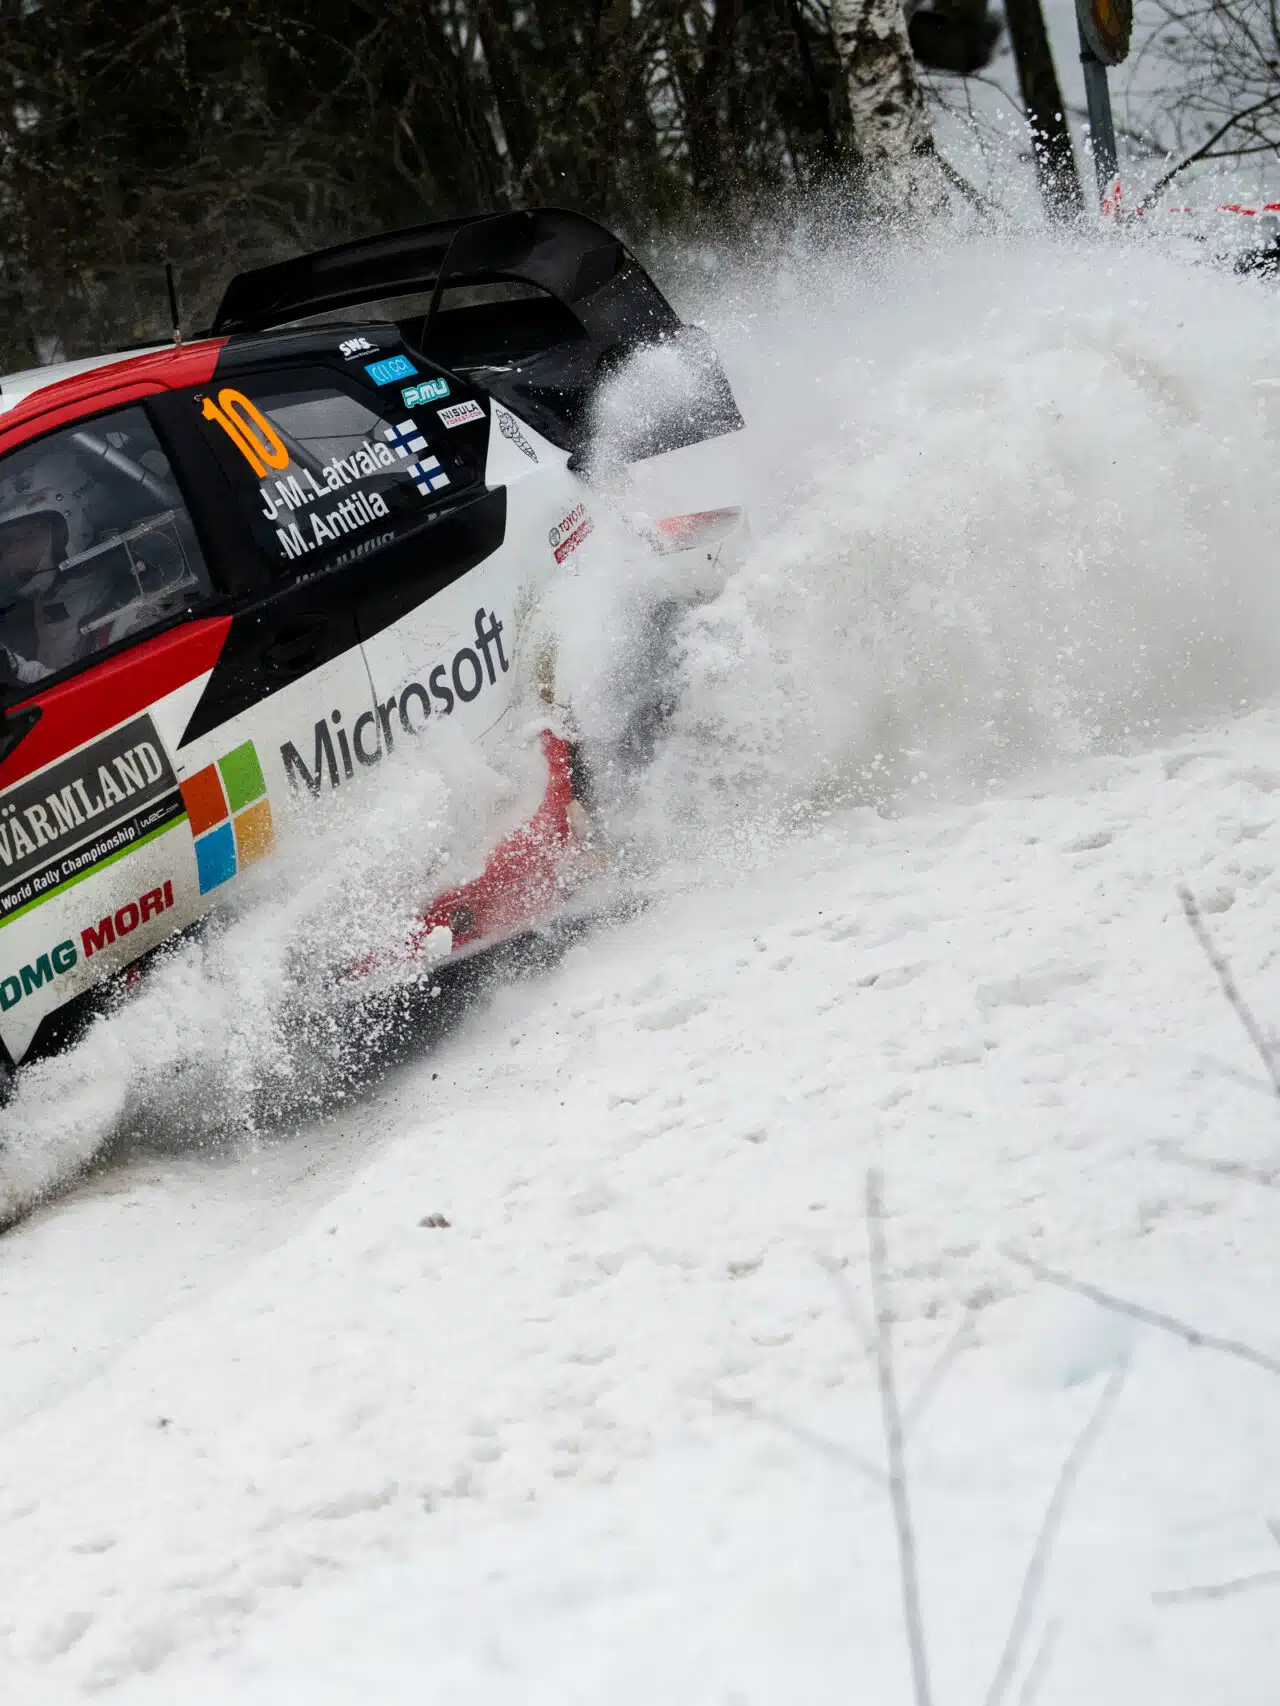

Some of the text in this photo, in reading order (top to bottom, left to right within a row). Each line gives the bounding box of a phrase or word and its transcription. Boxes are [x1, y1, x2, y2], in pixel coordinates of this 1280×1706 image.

[339, 338, 370, 357] SWS
[202, 388, 289, 478] 10
[441, 403, 479, 420] NISULA
[280, 607, 509, 799] Microsoft
[1, 885, 33, 912] World
[33, 869, 60, 892] Rally
[61, 826, 137, 875] Championship
[79, 879, 175, 958] MORI
